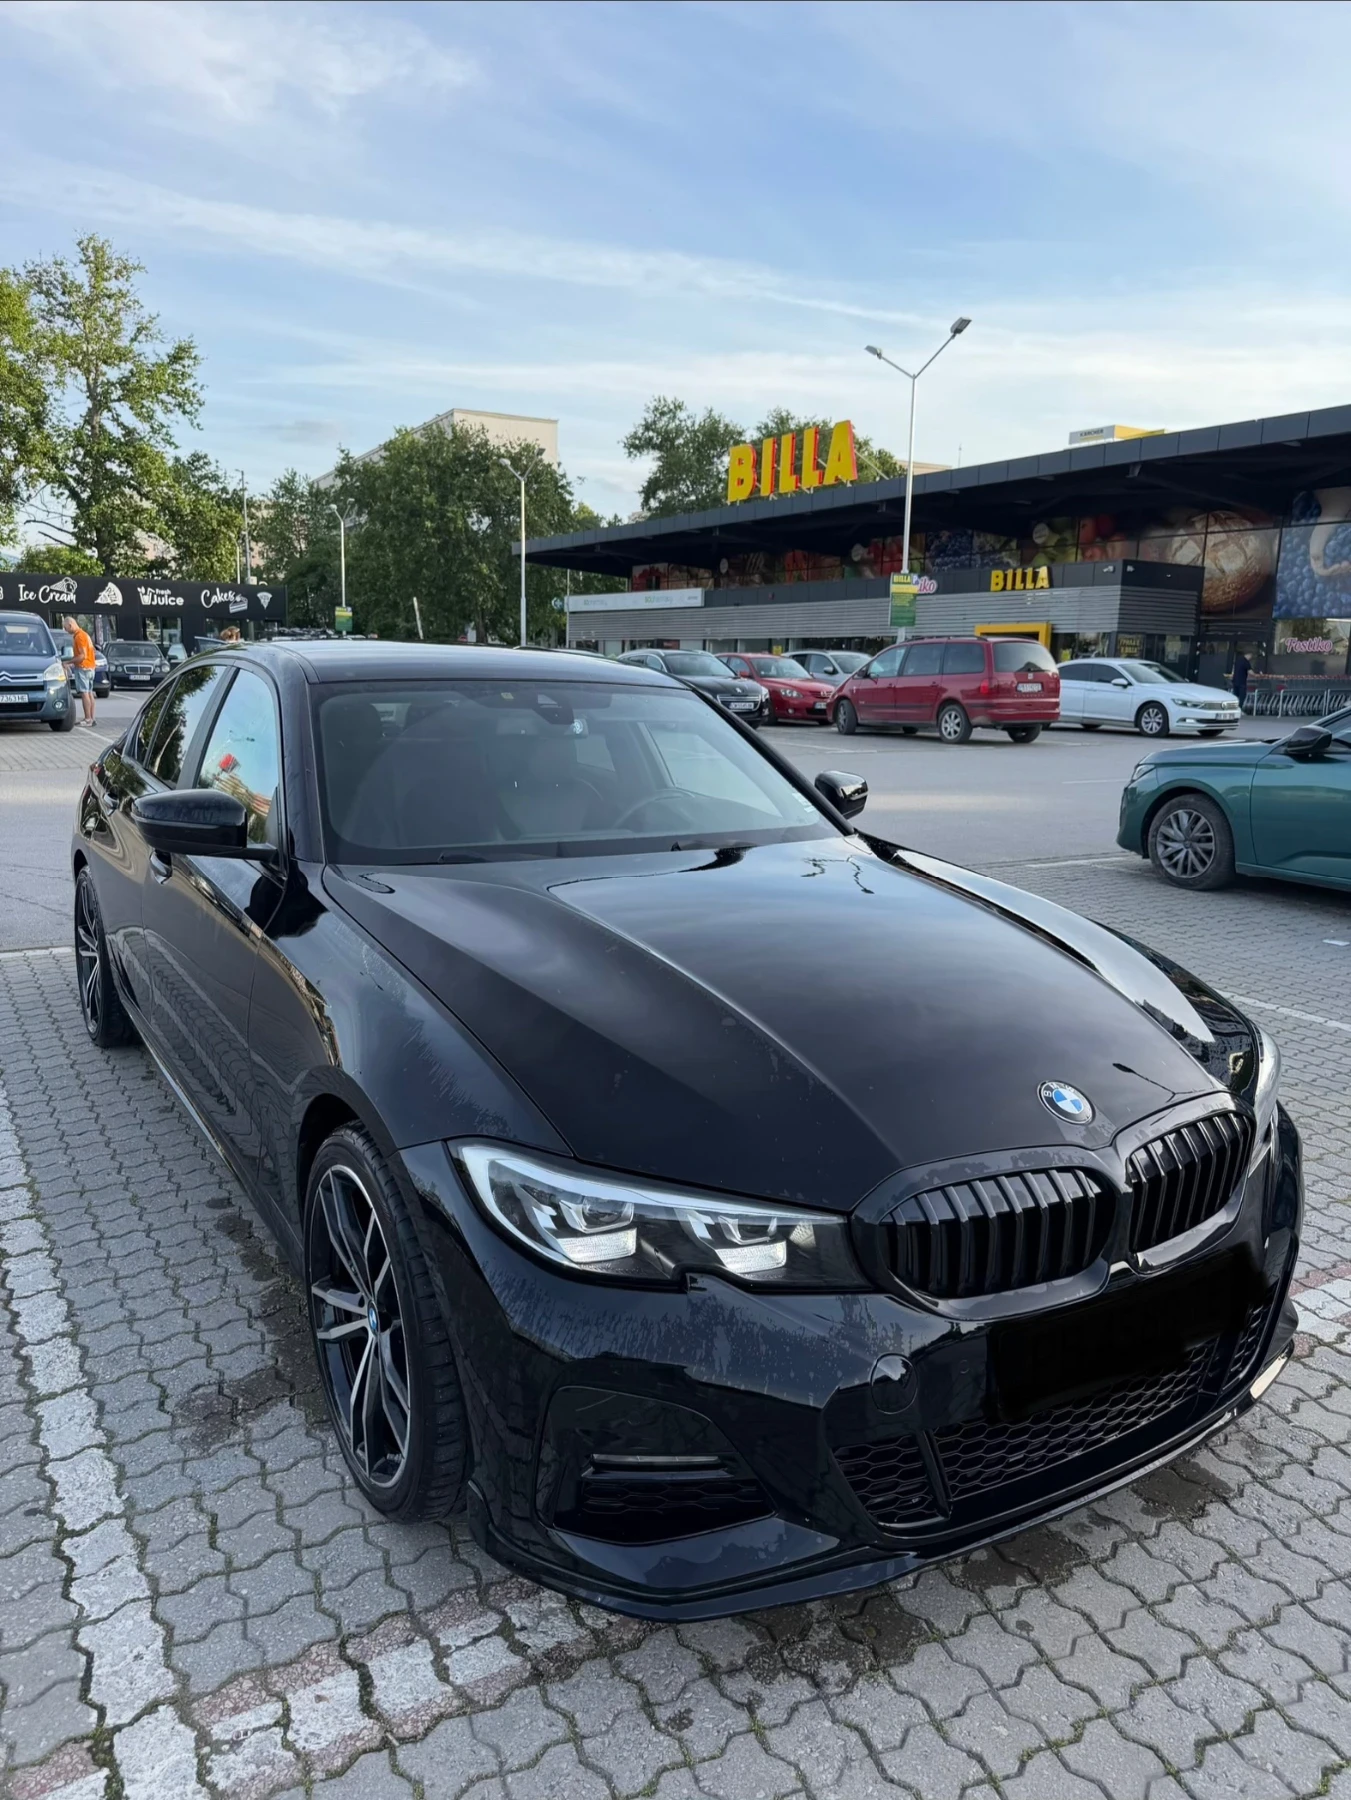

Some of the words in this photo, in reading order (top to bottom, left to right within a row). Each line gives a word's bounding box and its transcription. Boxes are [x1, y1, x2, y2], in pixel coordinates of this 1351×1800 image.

[727, 419, 858, 503] BILLA
[991, 566, 1050, 592] BILLA
[18, 584, 37, 602] Ice
[39, 585, 77, 604] Cream
[152, 593, 185, 606] Juice
[201, 587, 235, 608] Cakes
